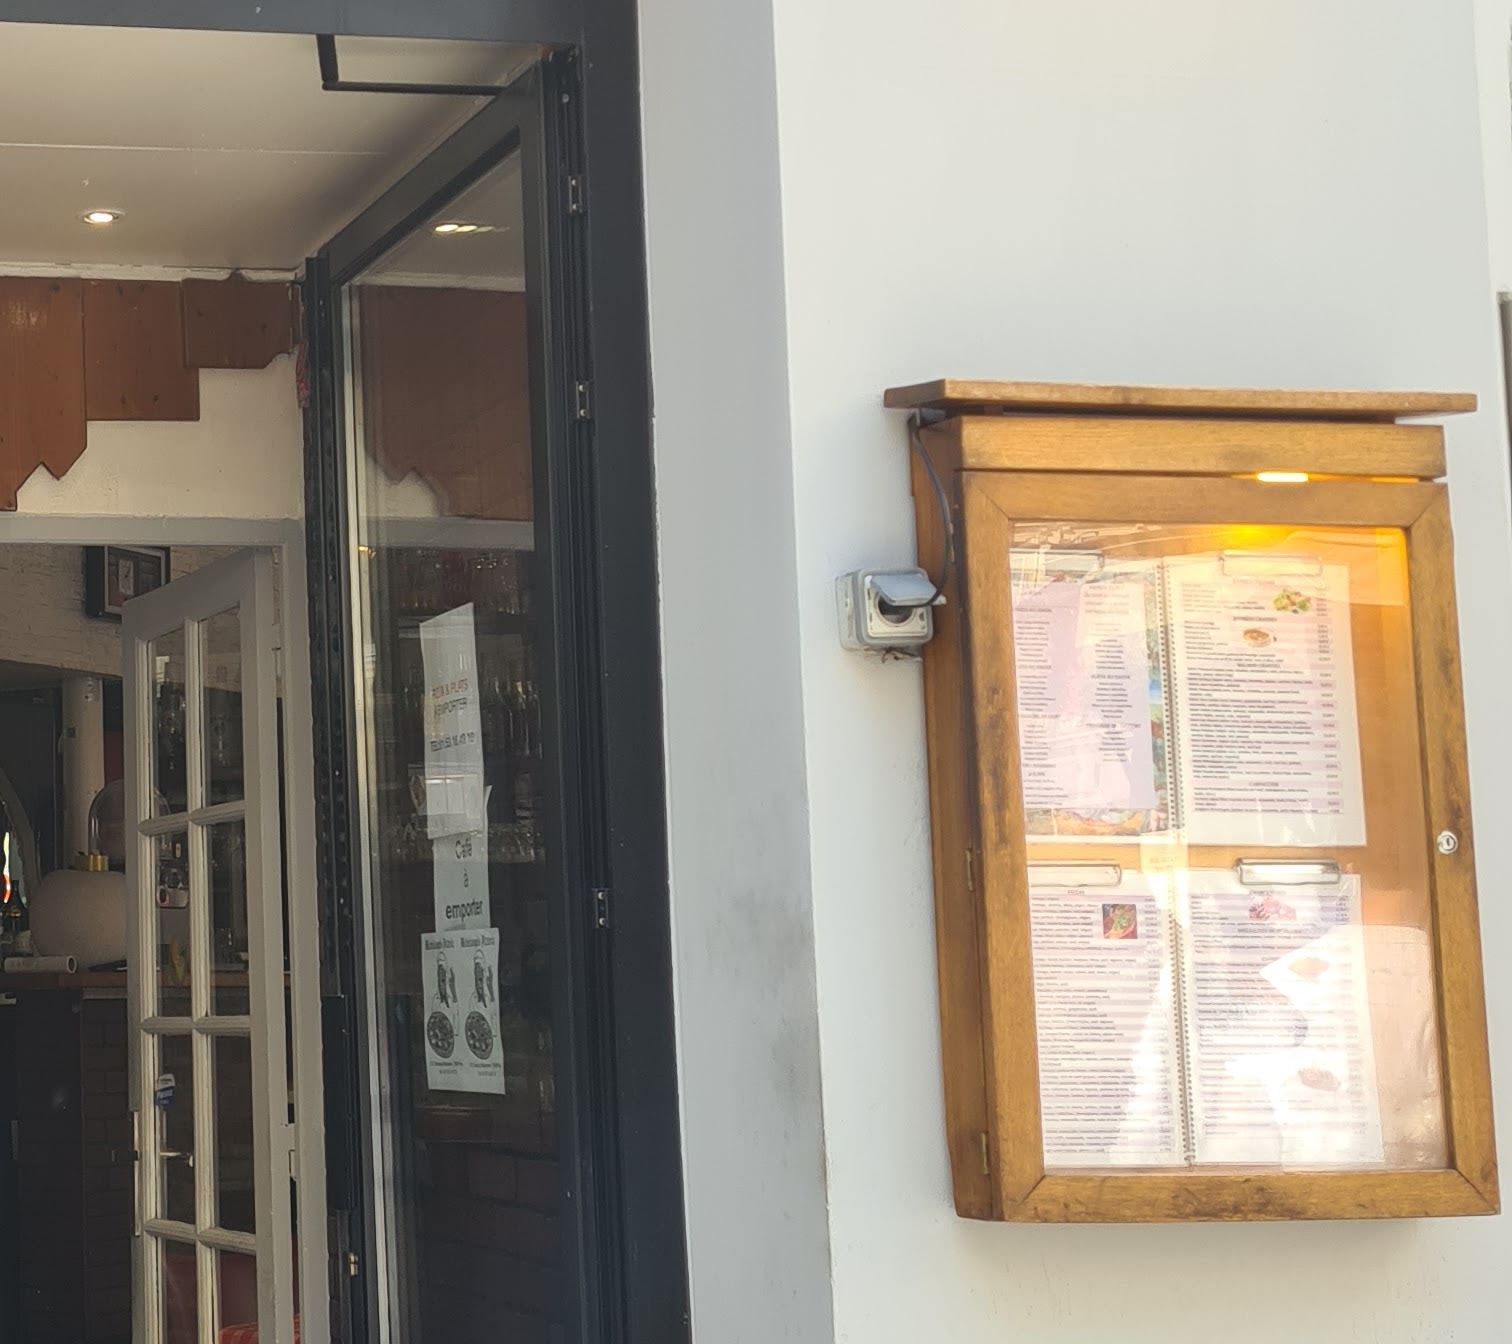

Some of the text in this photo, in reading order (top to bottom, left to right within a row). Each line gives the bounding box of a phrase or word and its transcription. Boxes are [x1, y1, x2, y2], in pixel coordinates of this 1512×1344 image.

[455, 838, 472, 859] Café
[463, 867, 469, 888] à
[445, 898, 483, 922] emporter
